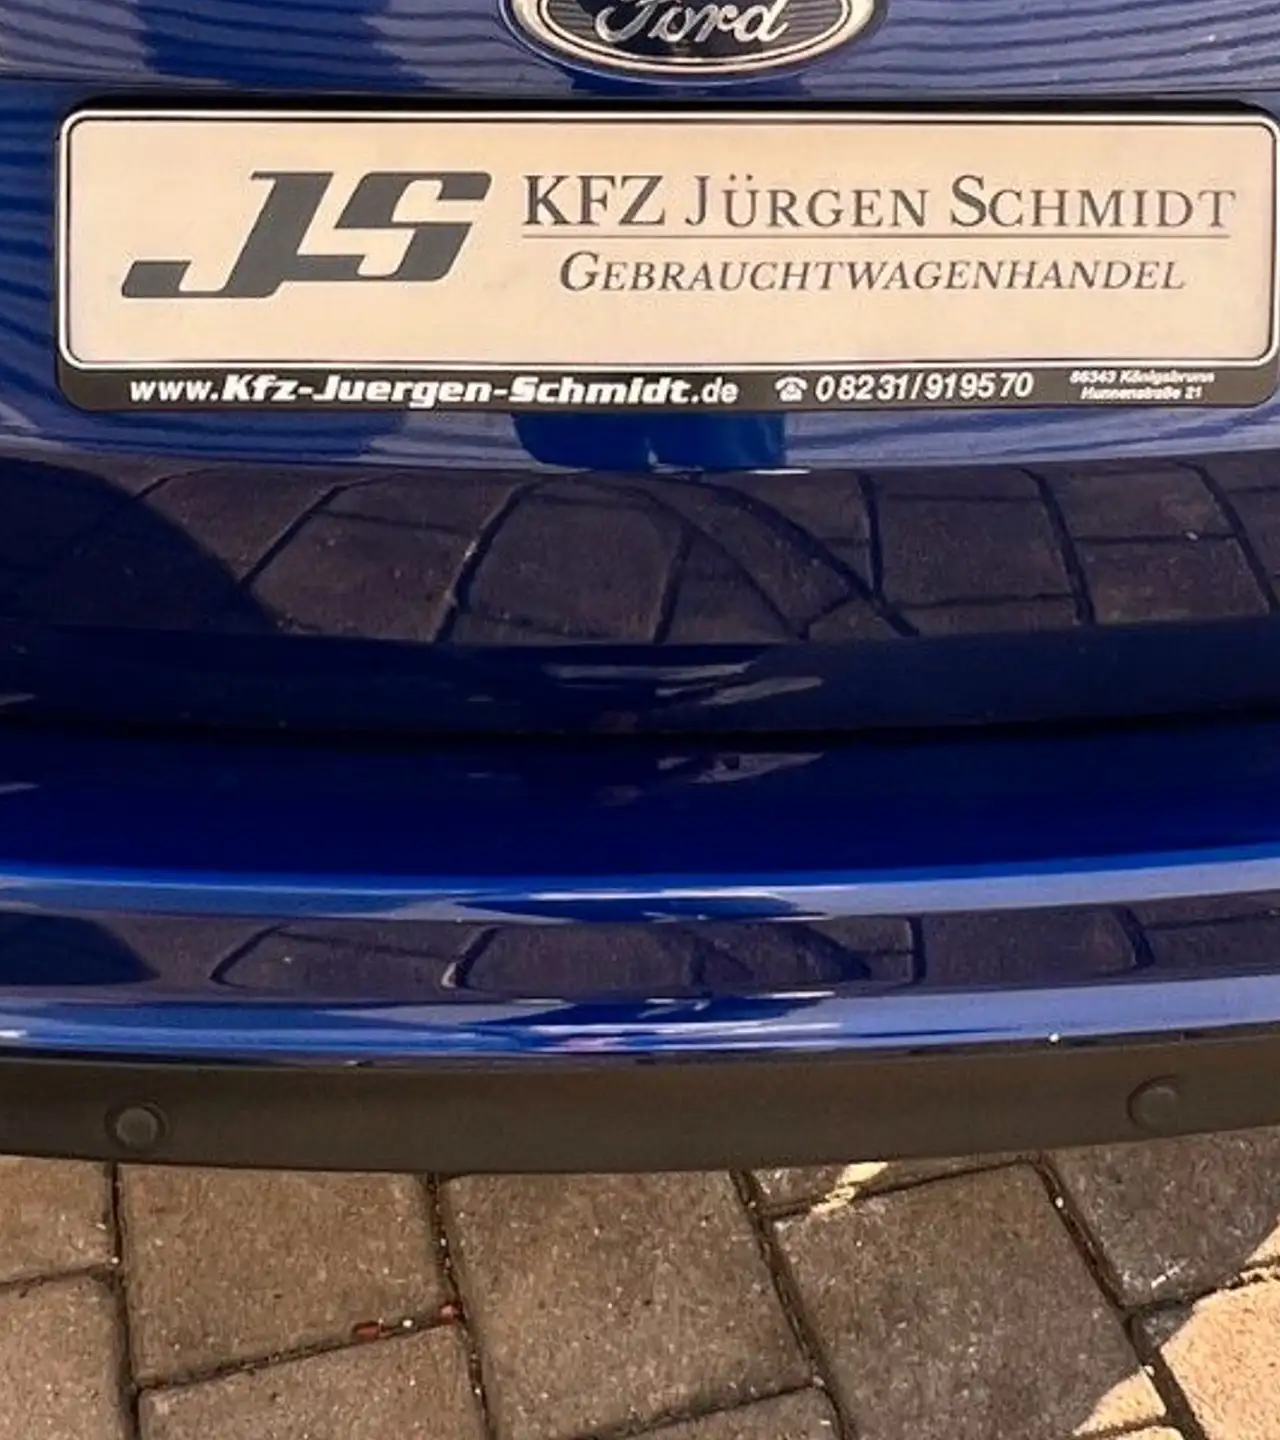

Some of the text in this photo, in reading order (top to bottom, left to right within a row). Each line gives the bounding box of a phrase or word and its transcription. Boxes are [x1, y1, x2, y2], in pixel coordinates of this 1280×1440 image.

[522, 173, 1236, 228] KFZ JÜRGEN SCHMIDT
[121, 171, 492, 299] JS
[559, 250, 1186, 292] GEBRAUCHTWAGENHANDEL
[129, 374, 738, 409] www.Kfz-Juergen-Schmidt.de
[815, 372, 1034, 402] 08231/919570
